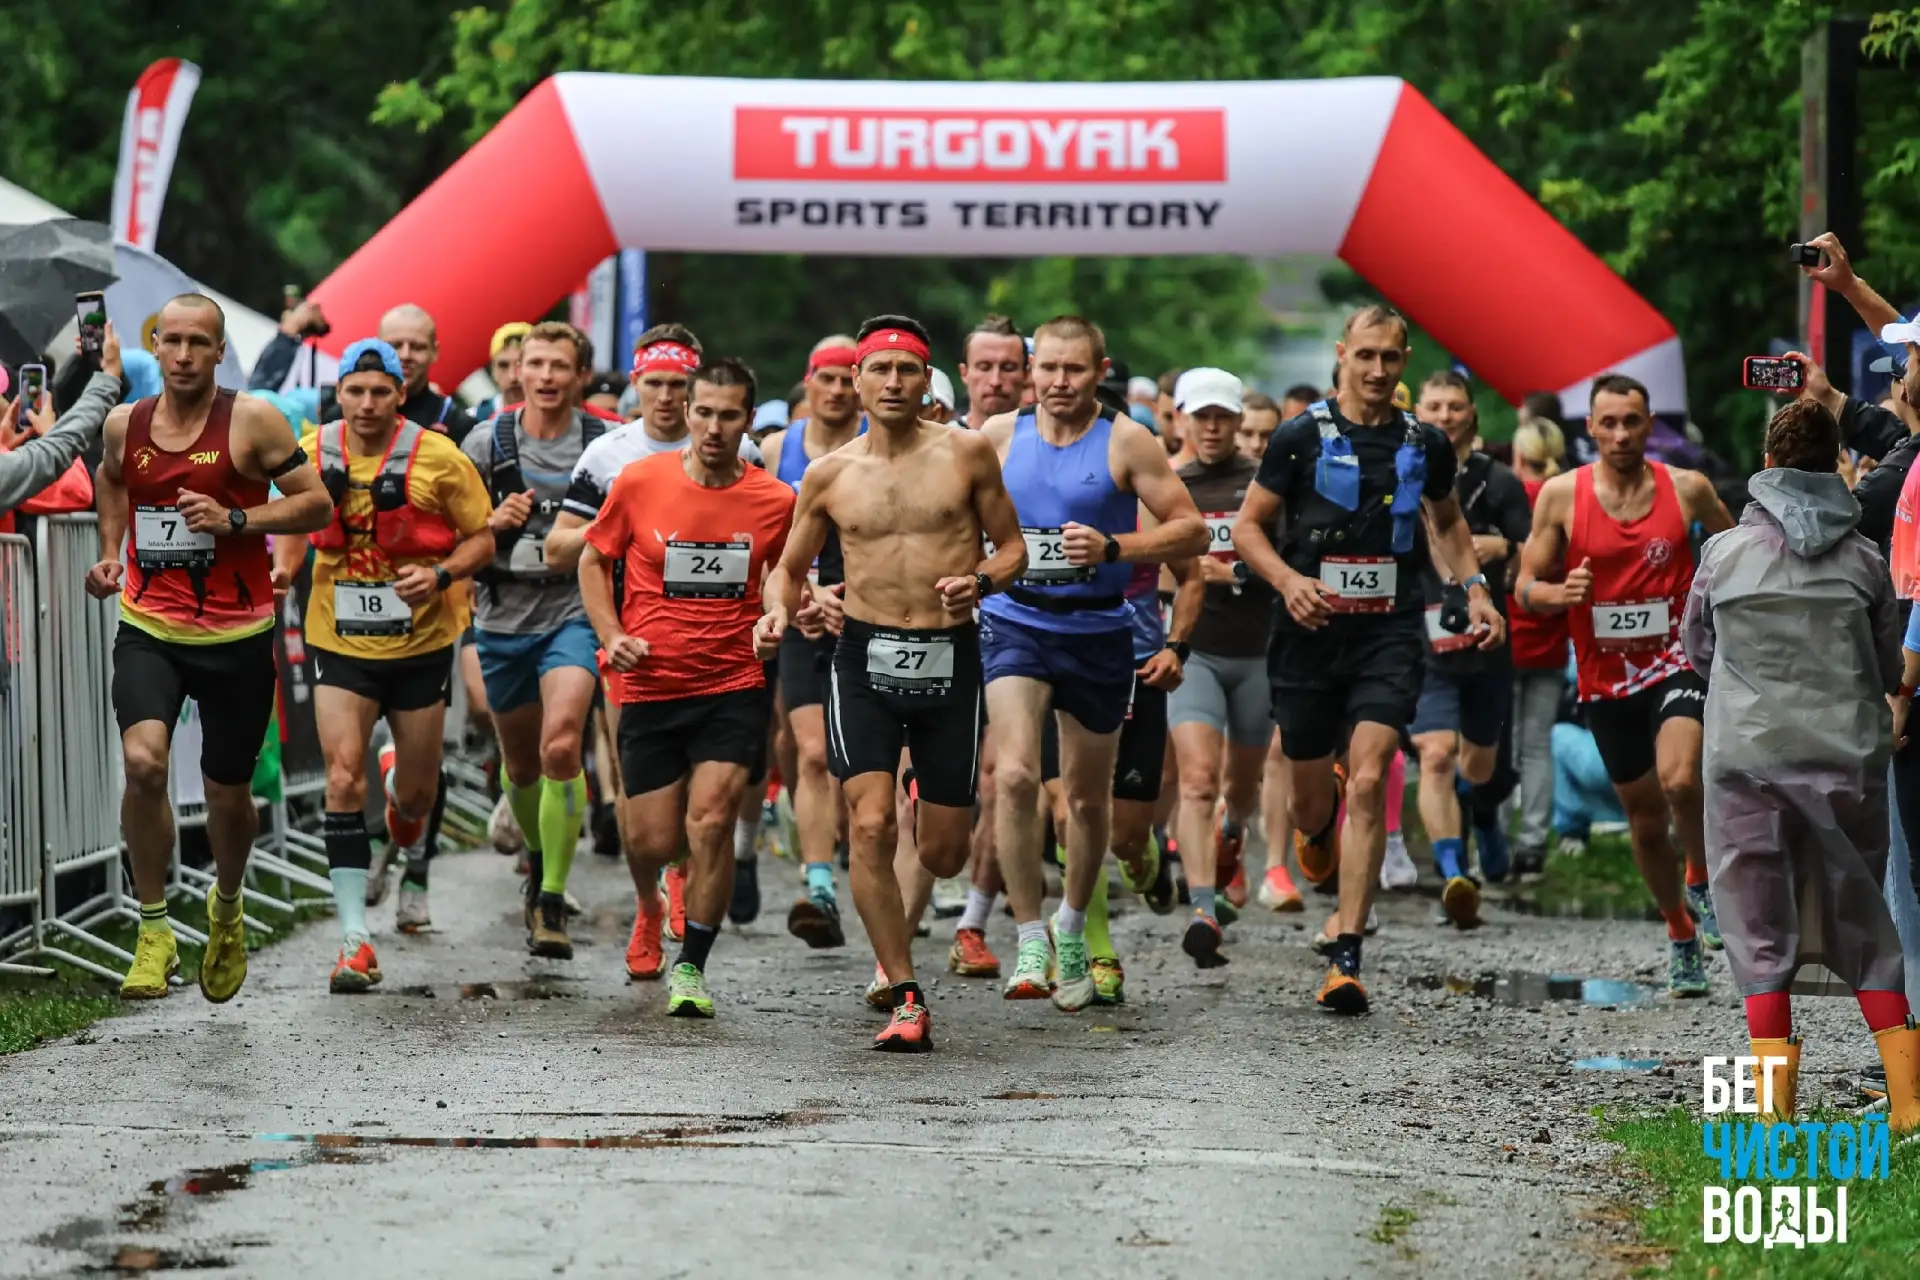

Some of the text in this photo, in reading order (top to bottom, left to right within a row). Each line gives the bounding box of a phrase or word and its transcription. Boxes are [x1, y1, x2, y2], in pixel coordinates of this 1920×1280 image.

[781, 117, 1181, 171] TURGOYAK
[735, 200, 1222, 228] SPORTS TERRITORY
[188, 451, 220, 465] RAY
[161, 521, 177, 541] 7
[691, 556, 723, 575] 24
[1340, 571, 1379, 589] 143
[359, 595, 382, 613] 18
[1610, 611, 1651, 630] 257
[895, 650, 927, 670] 27
